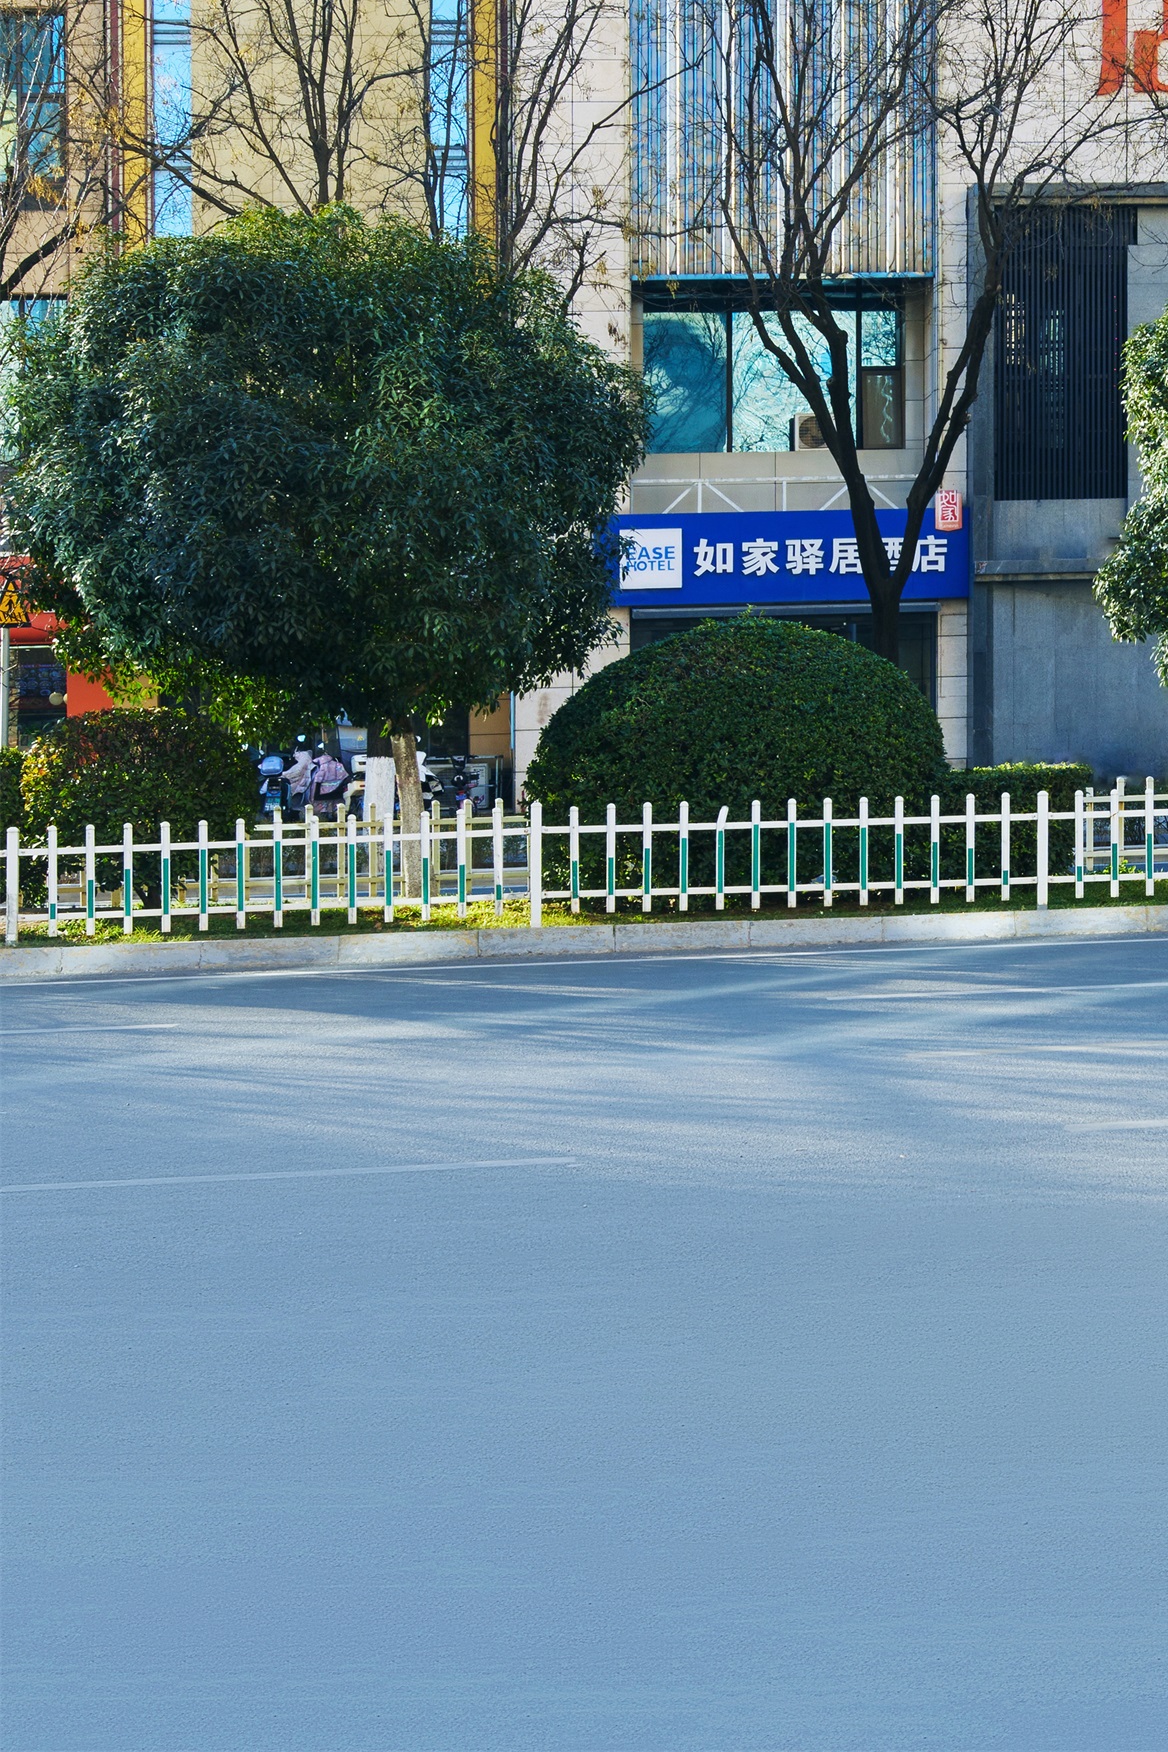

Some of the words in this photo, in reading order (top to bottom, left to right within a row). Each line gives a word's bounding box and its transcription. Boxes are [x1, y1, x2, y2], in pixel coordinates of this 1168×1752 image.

[940, 490, 959, 522] 如家
[627, 545, 676, 561] EASE
[626, 560, 675, 572] HOTEL
